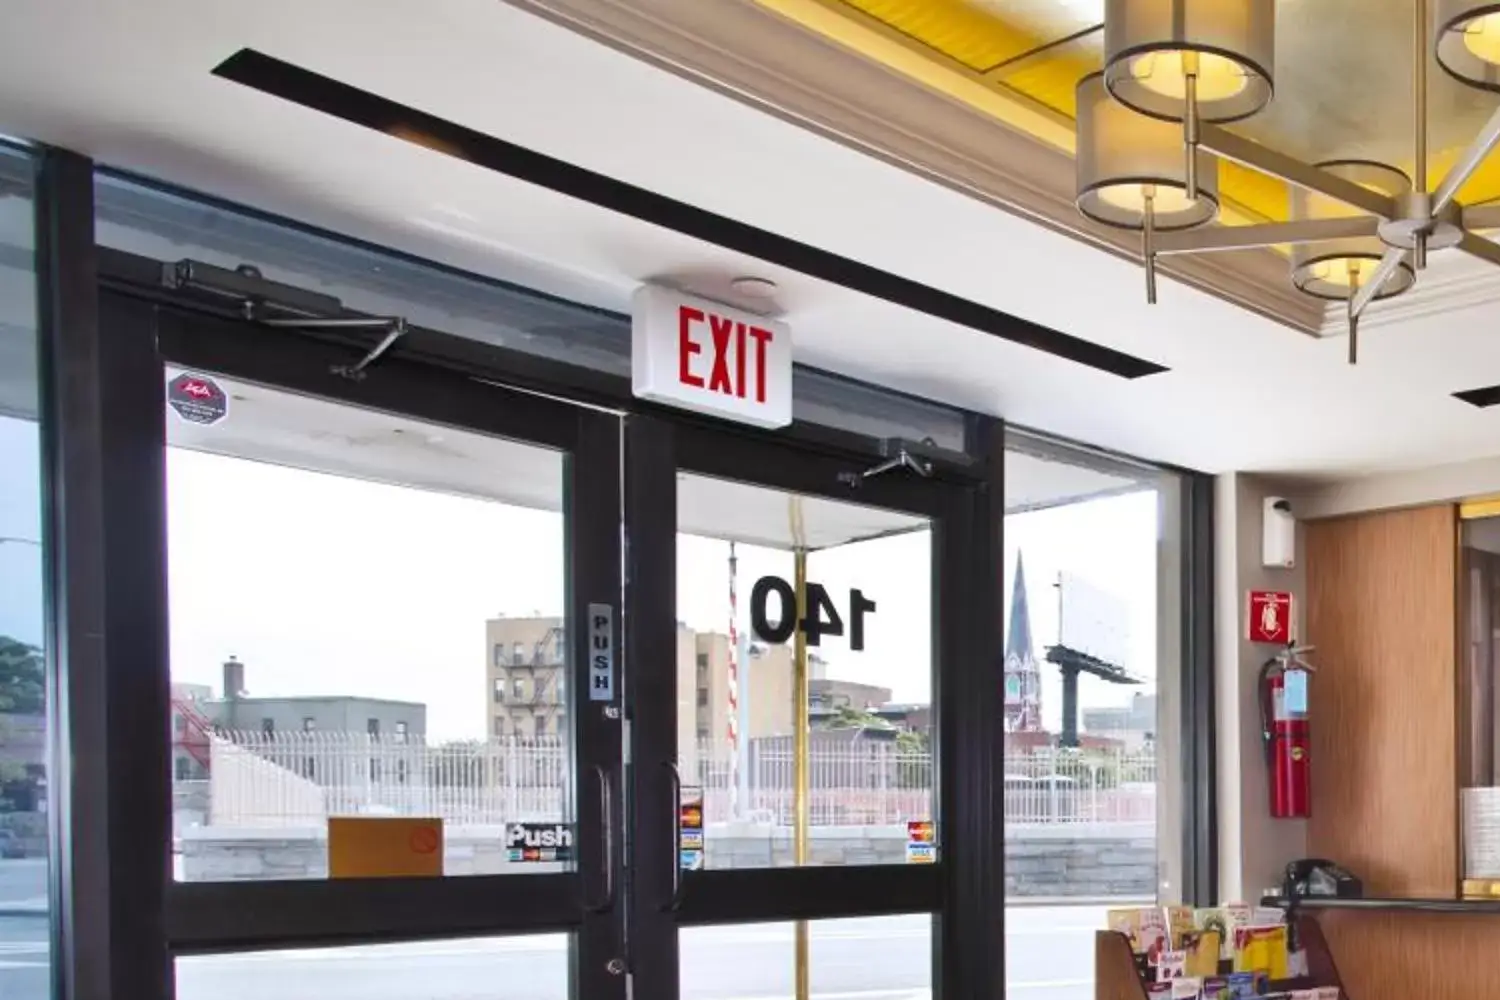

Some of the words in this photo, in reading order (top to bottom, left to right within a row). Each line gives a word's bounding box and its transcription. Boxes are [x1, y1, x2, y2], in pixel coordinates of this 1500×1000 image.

[680, 304, 773, 404] EXIT
[594, 614, 609, 690] PUSH
[506, 823, 573, 848] Push
